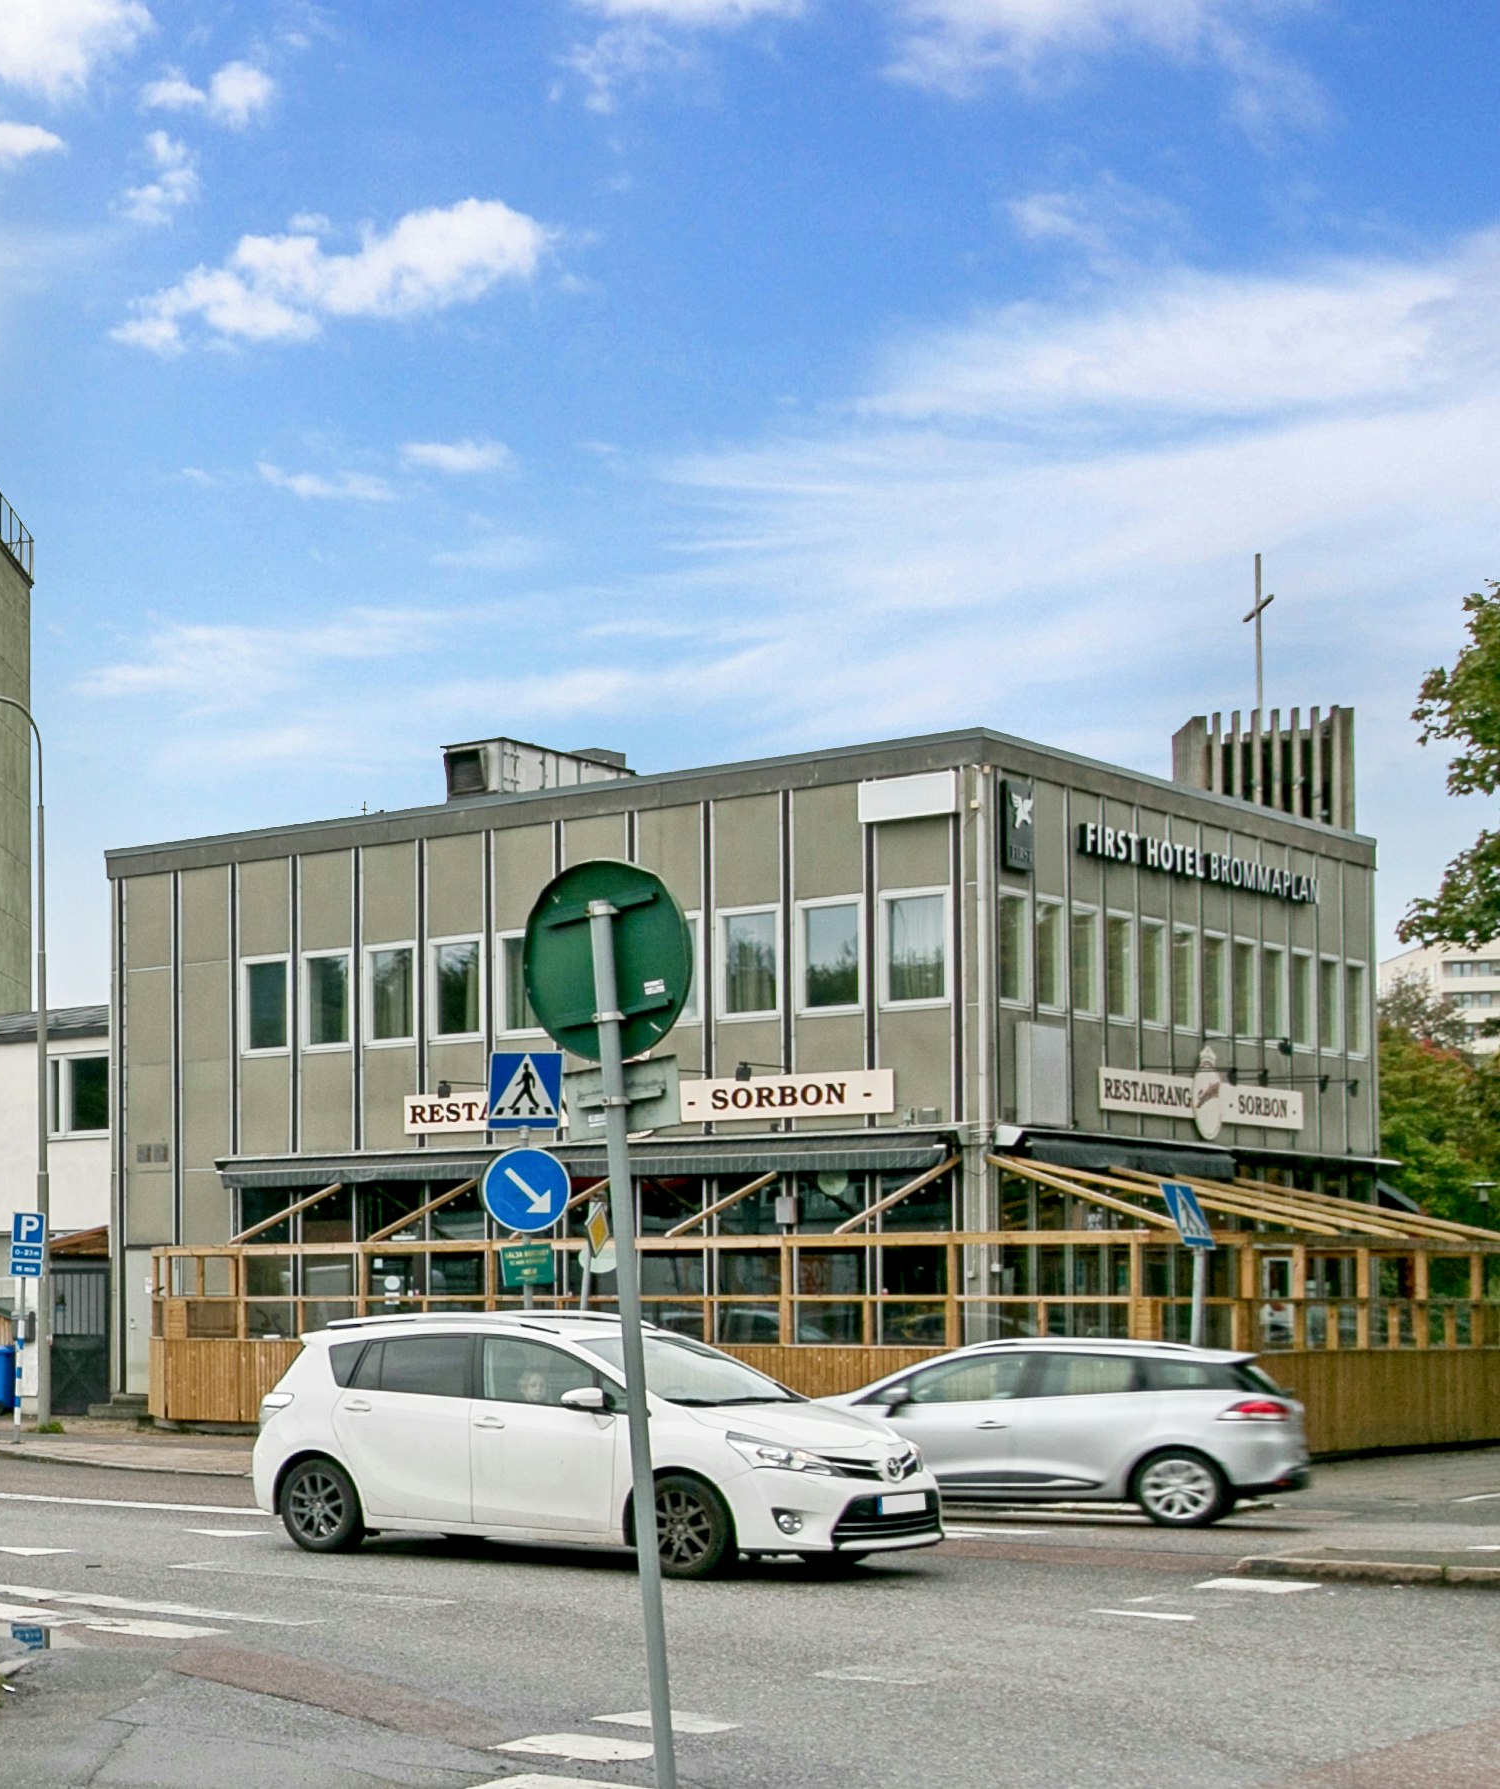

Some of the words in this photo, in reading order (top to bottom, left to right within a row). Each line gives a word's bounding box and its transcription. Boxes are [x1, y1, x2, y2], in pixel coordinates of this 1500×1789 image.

[1085, 821, 1140, 864] FIRST
[1146, 837, 1205, 880] HOTEL
[1210, 851, 1320, 905] BROMMAPLAN
[711, 1082, 847, 1111] SORBON
[1104, 1077, 1192, 1108] RESTAURANG
[1238, 1094, 1288, 1119] SORBON
[20, 1215, 40, 1241] P
